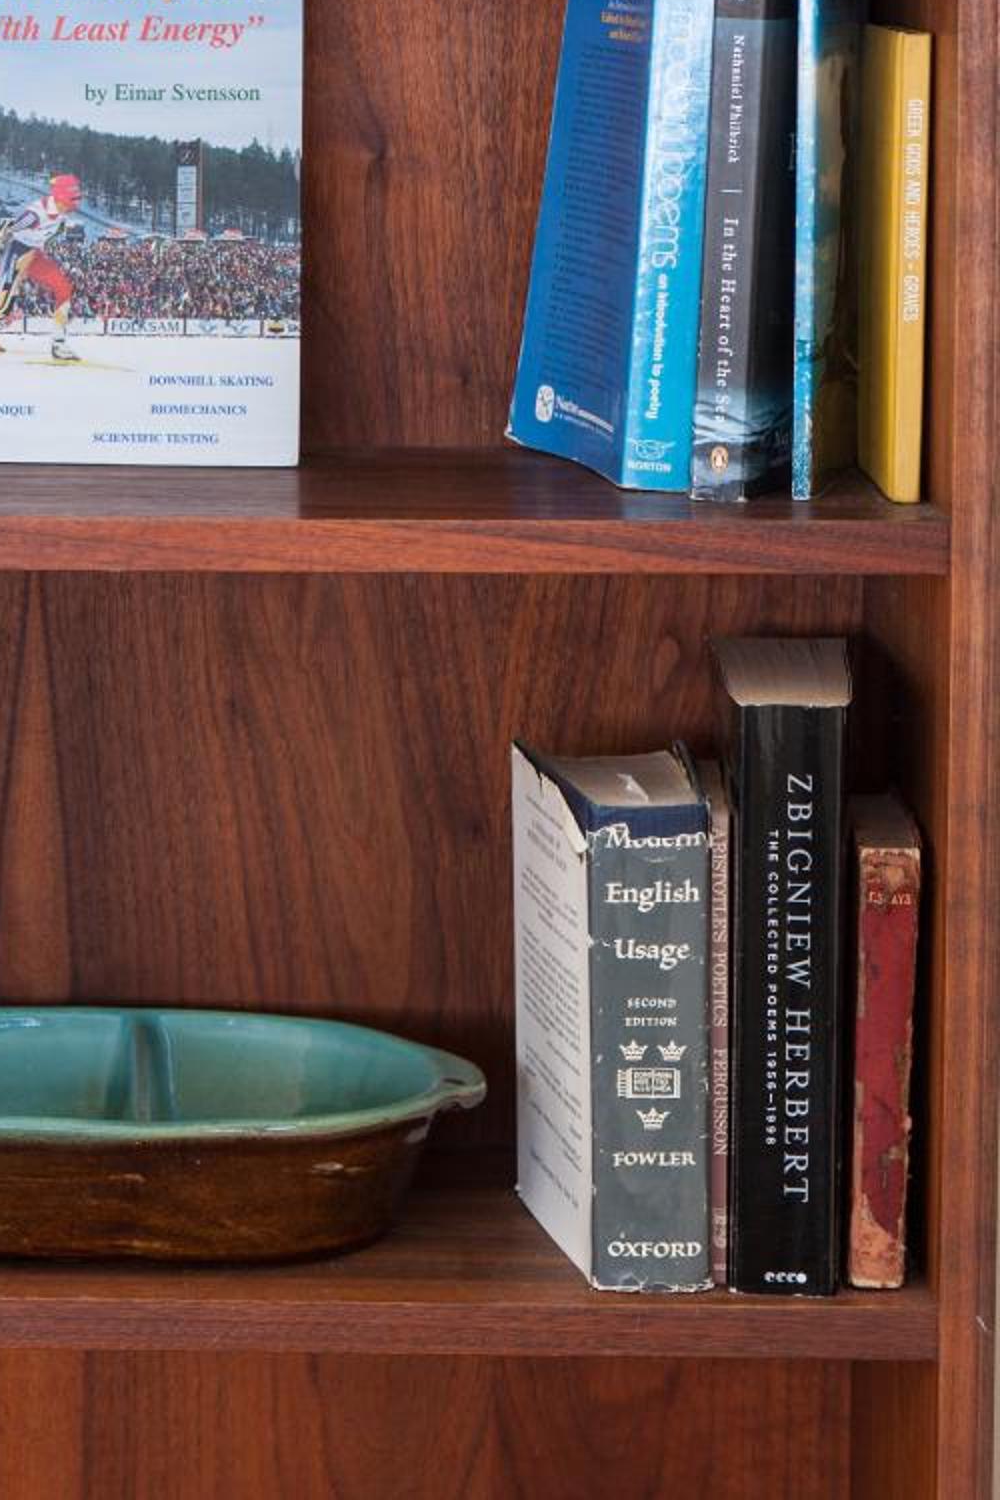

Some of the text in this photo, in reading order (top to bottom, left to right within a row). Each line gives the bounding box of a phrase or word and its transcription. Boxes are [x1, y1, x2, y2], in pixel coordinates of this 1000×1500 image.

[51, 15, 130, 42] Least
[84, 84, 261, 105] by Einar Svensson
[727, 35, 745, 163] Nathaniel Philbrick
[904, 179, 921, 204] AND
[651, 153, 688, 270] poems
[903, 211, 921, 259] HEROES
[902, 274, 920, 323] GRAVES
[111, 319, 180, 333] FOLKSAM
[652, 291, 670, 361] introduction
[713, 217, 740, 423] In the Heart of the Sea
[148, 375, 274, 387] DOWNHILL SKATING
[651, 363, 665, 377] to
[150, 405, 248, 416] BIOMECHANICS
[644, 379, 662, 419] poetry
[92, 433, 219, 445] SCIENTIFIC TESTING
[627, 460, 672, 473] NORTON
[767, 829, 780, 862] THE
[605, 879, 700, 912] English
[767, 871, 779, 974] COLLECTED
[614, 939, 691, 970] Usage
[627, 998, 677, 1008] SECOND
[713, 951, 728, 1028] POETICS
[783, 773, 813, 1203] ZBIGNIEW HERBERT
[625, 1016, 677, 1027] EDITION
[766, 982, 778, 1042] POEMS
[713, 1047, 729, 1156] FERGUSSON
[613, 1152, 696, 1167] FOWLER
[607, 1241, 702, 1258] OXFORD
